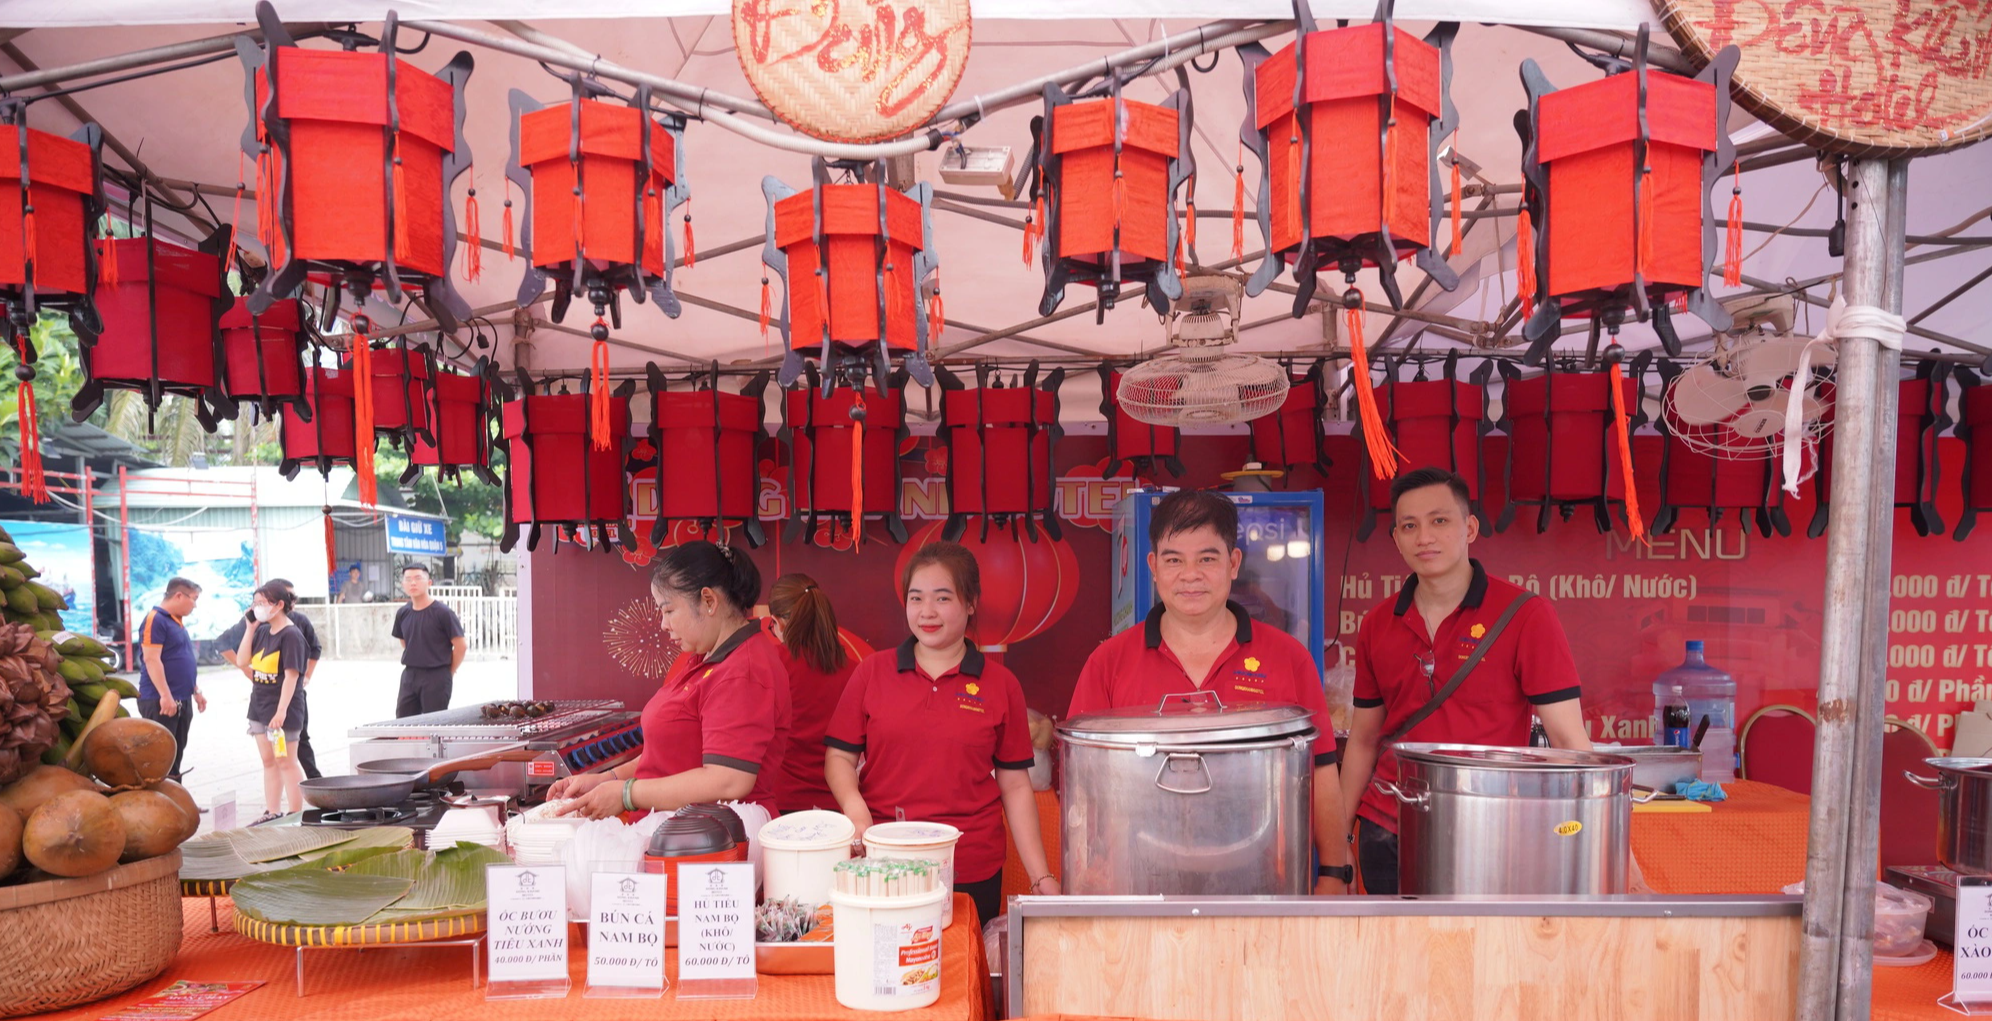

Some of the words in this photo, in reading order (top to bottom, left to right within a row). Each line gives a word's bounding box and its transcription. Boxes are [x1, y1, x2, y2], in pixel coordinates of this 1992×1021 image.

[423, 523, 433, 535] XE
[1606, 529, 1746, 559] MENU
[1340, 572, 1373, 599] Hủ
[1550, 574, 1617, 601] (Khô/
[1624, 573, 1697, 601] Nước)
[1946, 575, 1971, 598] đ/
[1977, 575, 1992, 598] T
[1944, 610, 1970, 633] đ/
[1975, 610, 1992, 633] T
[1942, 645, 1968, 668] đ/
[1908, 679, 1933, 702] đ/
[600, 909, 629, 924] BÚN
[634, 910, 654, 925] CÁ
[694, 914, 720, 923] NAM
[724, 912, 739, 925] BỘ
[599, 931, 632, 943] NAM
[638, 931, 658, 947] BỘ
[701, 926, 734, 938] (KHÔ/
[526, 938, 563, 949] XANH
[699, 940, 736, 952] NƯỚC)
[1960, 943, 1992, 958] XÀO
[494, 955, 523, 964] 40.000
[594, 956, 627, 967] 50.000
[645, 956, 659, 968] TÔ
[684, 957, 719, 966] 60.000
[736, 954, 750, 965] TÔ
[1961, 972, 1988, 980] 60.000
